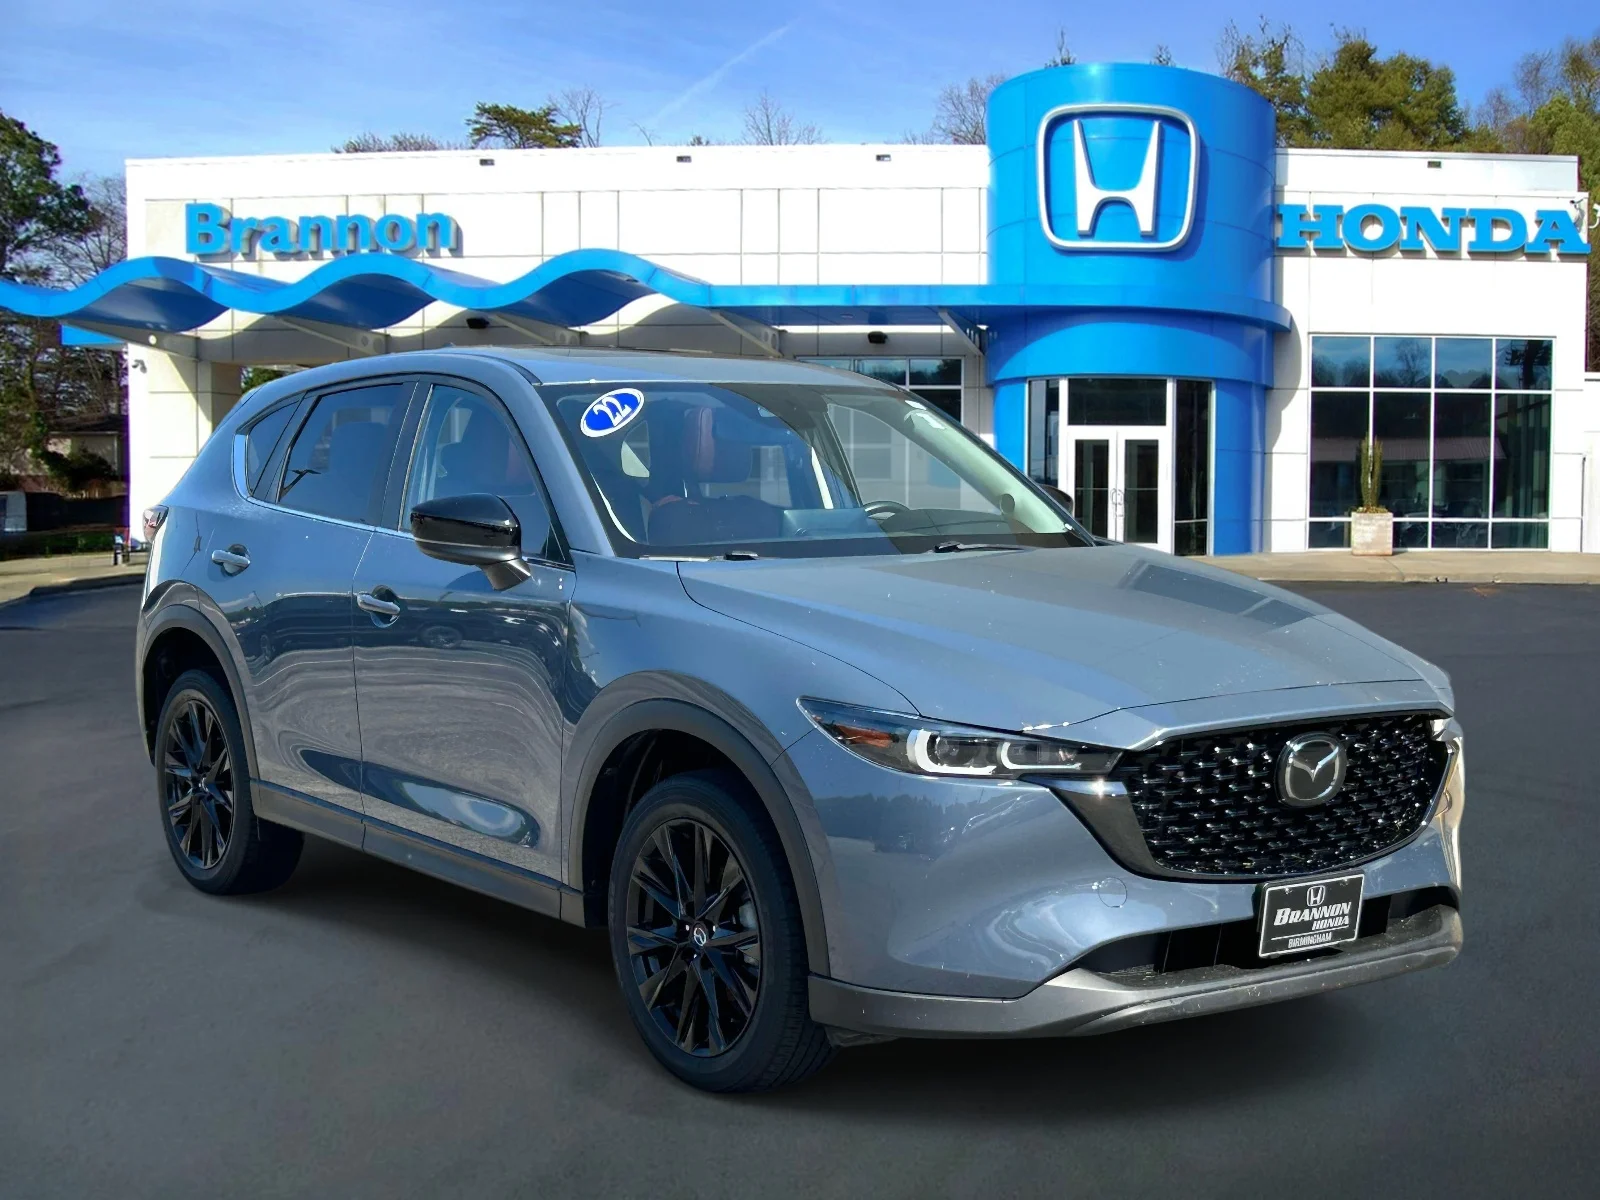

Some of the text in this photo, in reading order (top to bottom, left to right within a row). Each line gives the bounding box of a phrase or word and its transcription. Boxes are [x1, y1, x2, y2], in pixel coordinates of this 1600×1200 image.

[185, 202, 460, 256] Brannon
[1277, 203, 1591, 254] HONDA
[592, 396, 633, 427] 22
[1273, 901, 1352, 926] BRANNON
[1311, 915, 1349, 931] HONDA
[1288, 932, 1332, 948] BIRMINGHAM
